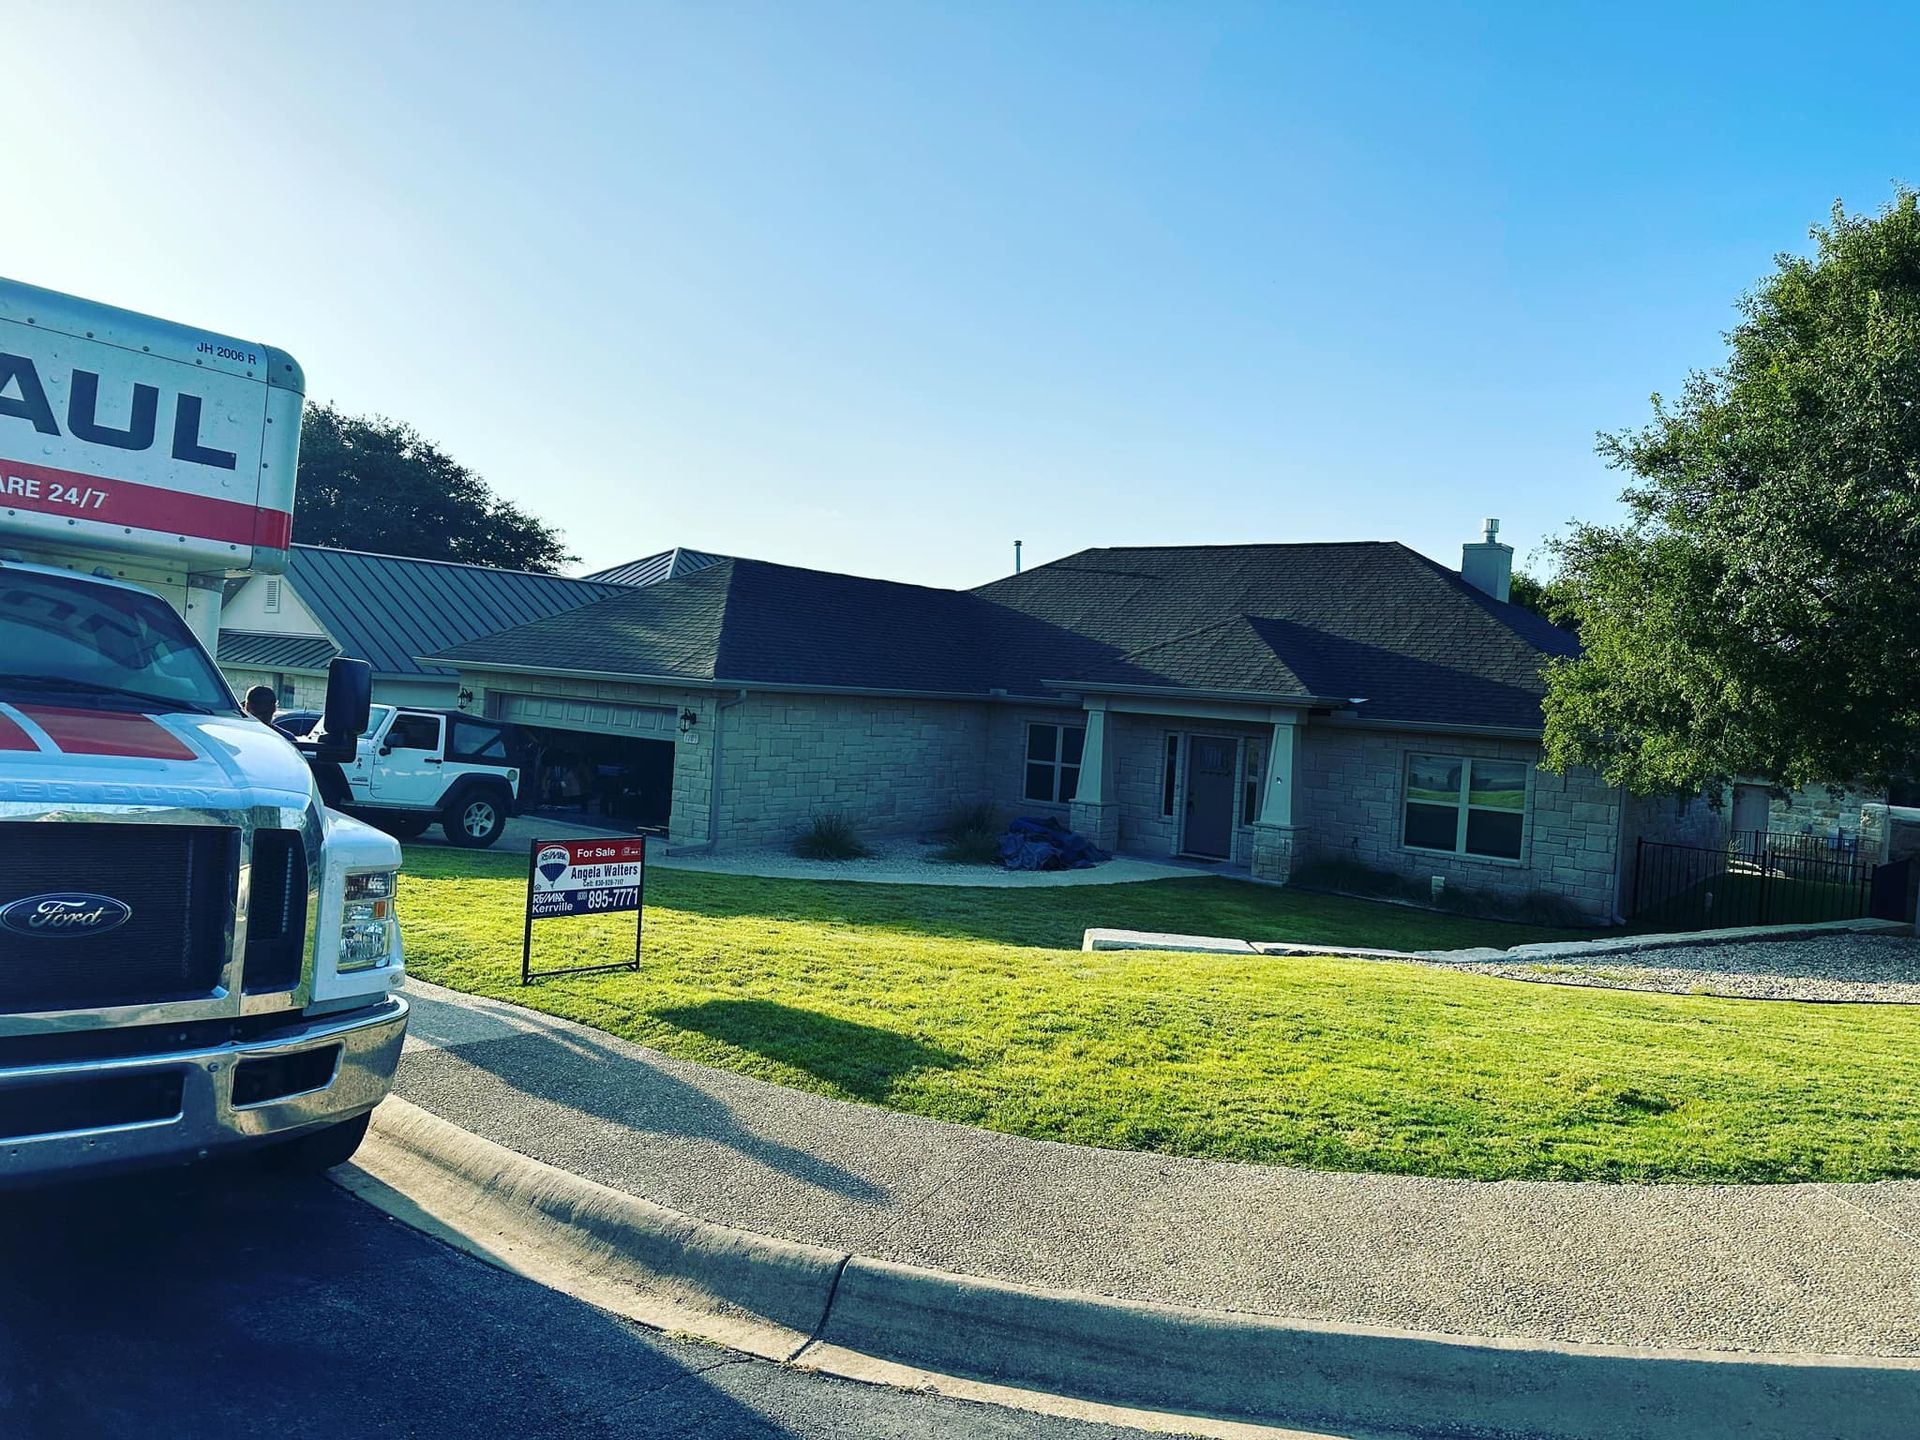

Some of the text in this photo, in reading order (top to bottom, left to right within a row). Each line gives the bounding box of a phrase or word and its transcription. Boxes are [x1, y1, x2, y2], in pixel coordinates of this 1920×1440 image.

[196, 342, 257, 365] JH 2006 R
[47, 483, 107, 508] 24/7
[0, 780, 218, 803] ER DUTY
[577, 847, 616, 858] For Sale
[571, 864, 638, 881] Angela Walters
[532, 902, 573, 914] Kerrville
[533, 892, 566, 904] RE/MAX
[587, 887, 639, 909] 895-7771
[28, 900, 104, 928] Ford
